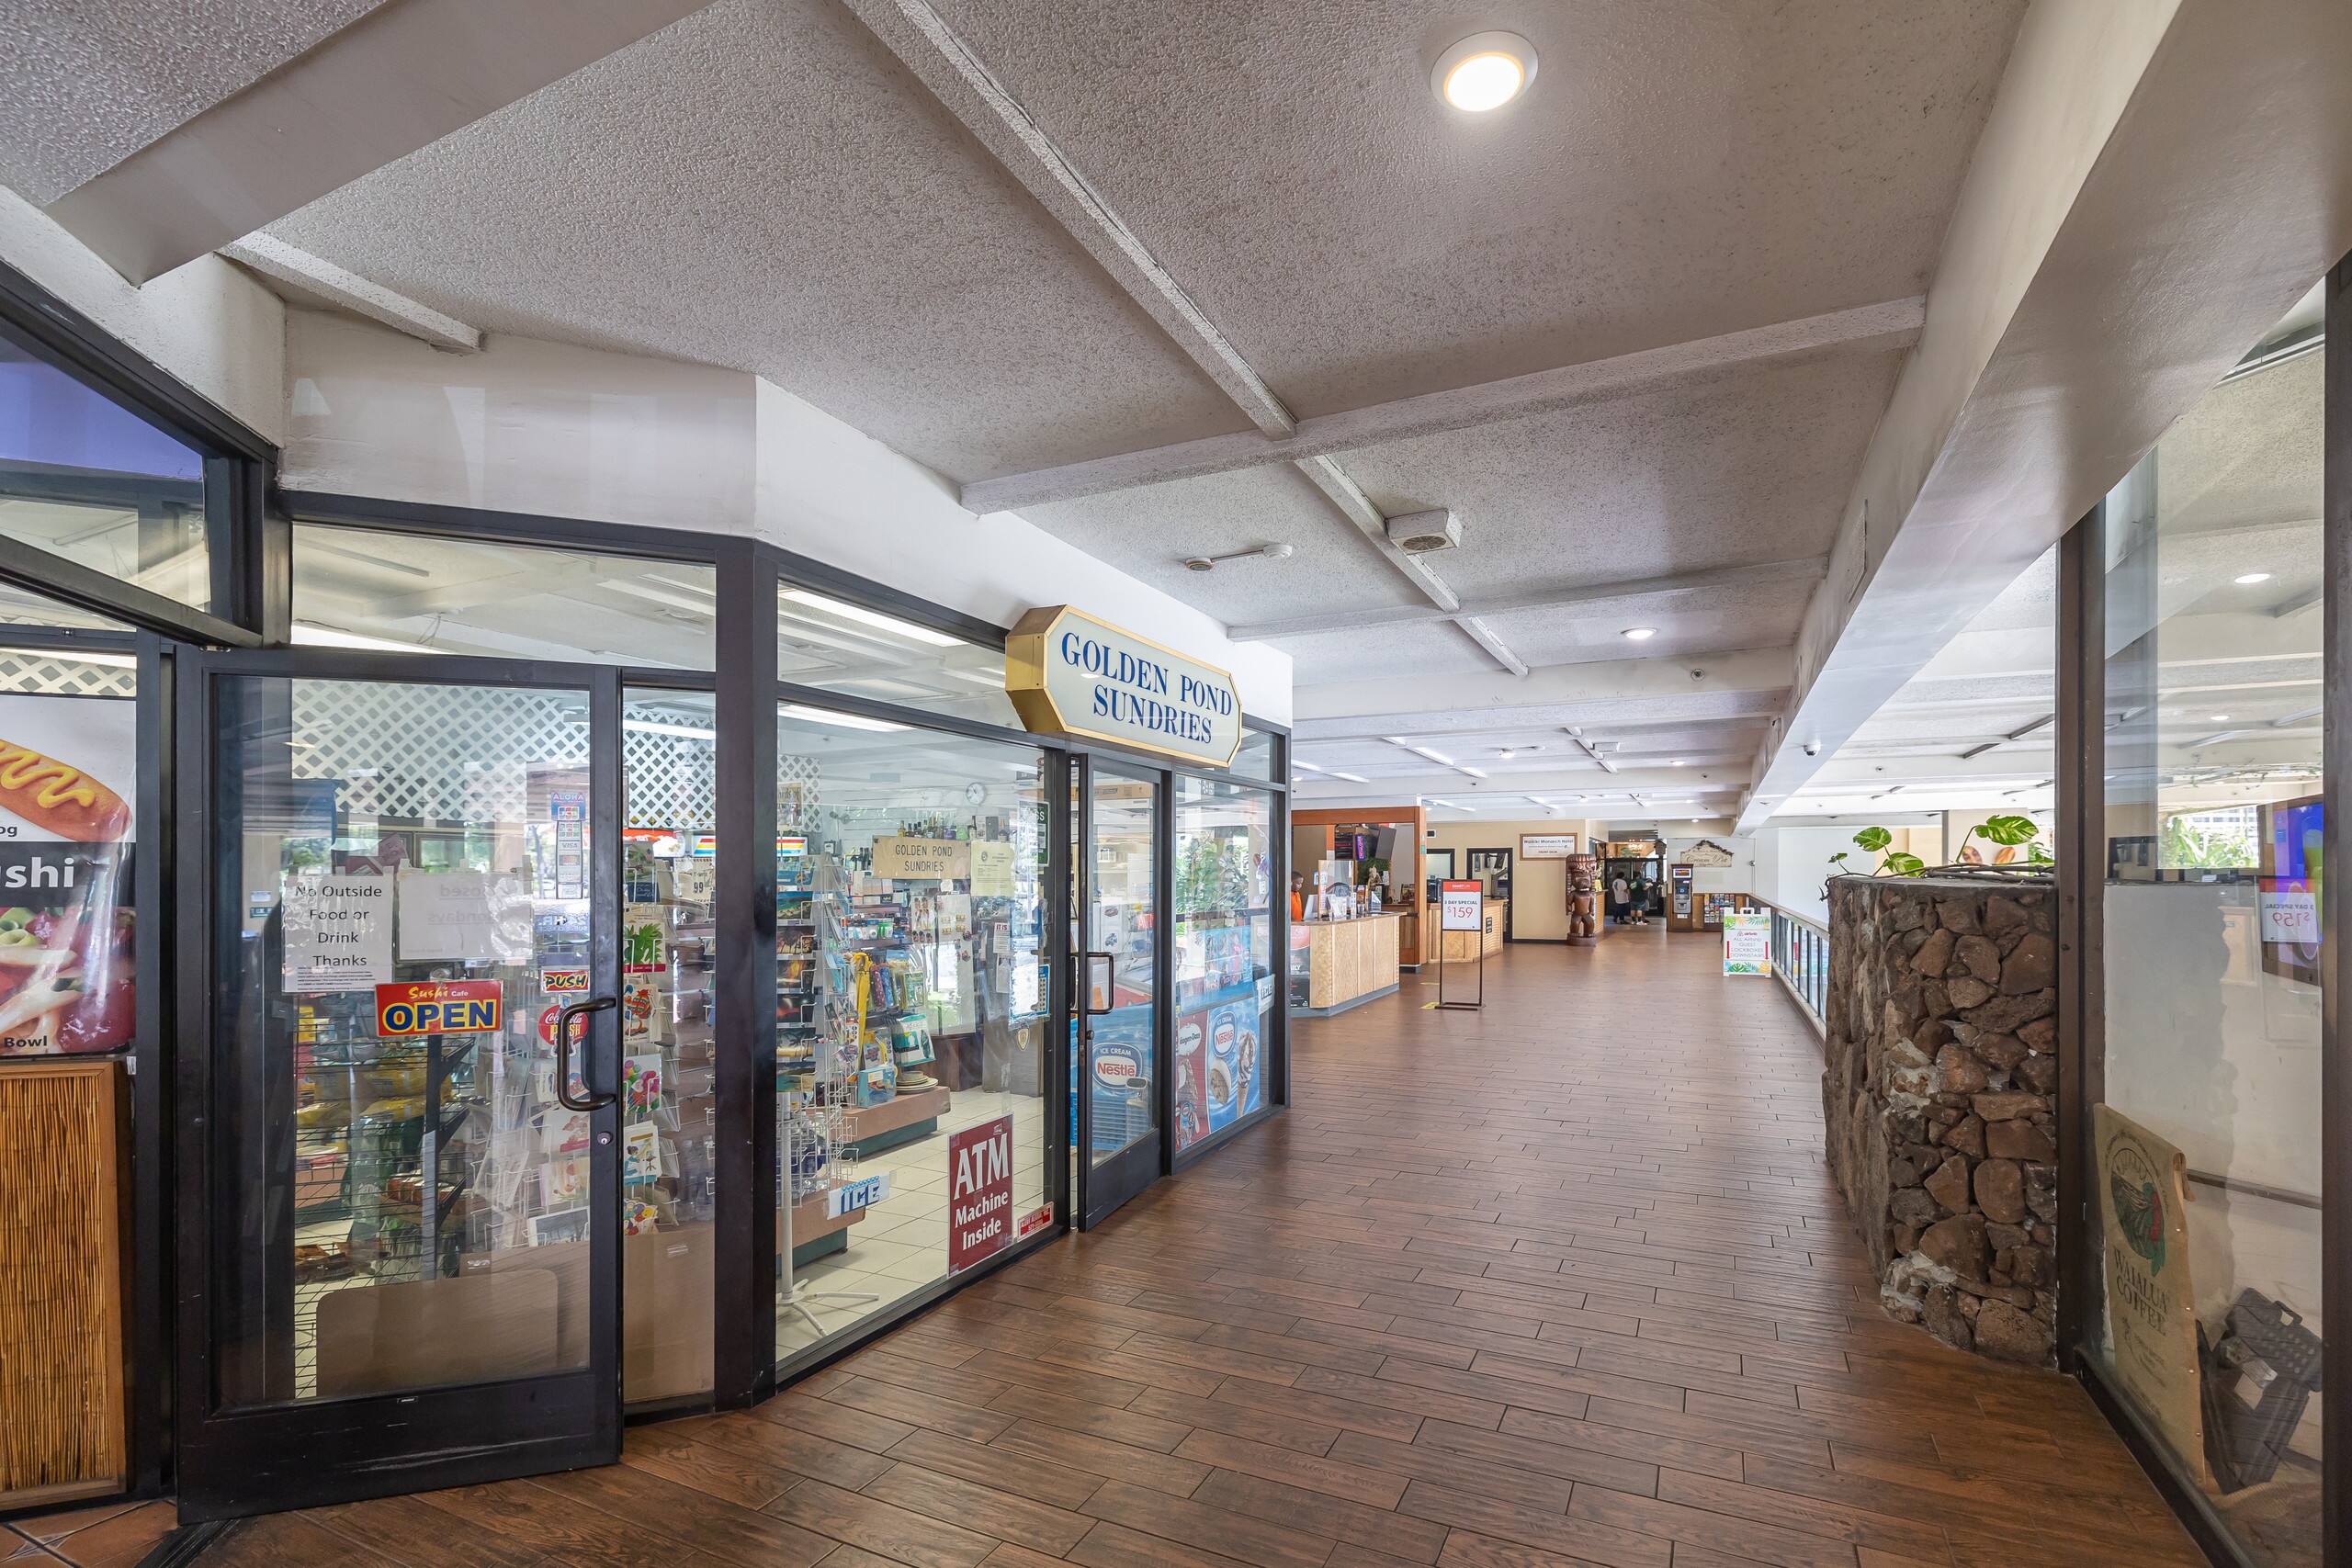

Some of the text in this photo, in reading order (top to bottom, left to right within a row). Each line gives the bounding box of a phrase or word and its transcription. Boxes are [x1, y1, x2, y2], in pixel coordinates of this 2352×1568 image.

[1061, 632, 1232, 716] GOLDEN POND
[1093, 684, 1212, 744] SUNDRIES
[553, 793, 584, 801] ALOHA
[895, 844, 953, 857] GOLDEN POND
[0, 856, 74, 888] shi
[904, 861, 944, 872] SUNDRIES
[295, 886, 382, 897] No Outside
[310, 909, 369, 920] Food or
[1447, 907, 1473, 918] $159
[318, 931, 359, 943] Drink
[312, 954, 368, 966] Thanks
[544, 974, 588, 987] PUSH
[408, 986, 448, 999] Sushi
[383, 999, 497, 1033] OPEN
[549, 1023, 581, 1041] PSH
[4, 1035, 47, 1047] Bowl
[1110, 1047, 1131, 1056] CREAM
[953, 1132, 1010, 1201] ATM
[841, 1182, 880, 1216] ICE
[955, 1190, 1008, 1229] Machine
[962, 1217, 1001, 1251] Inside
[2114, 1247, 2167, 1314] WAIALUA
[2117, 1275, 2165, 1337] COFFEE
